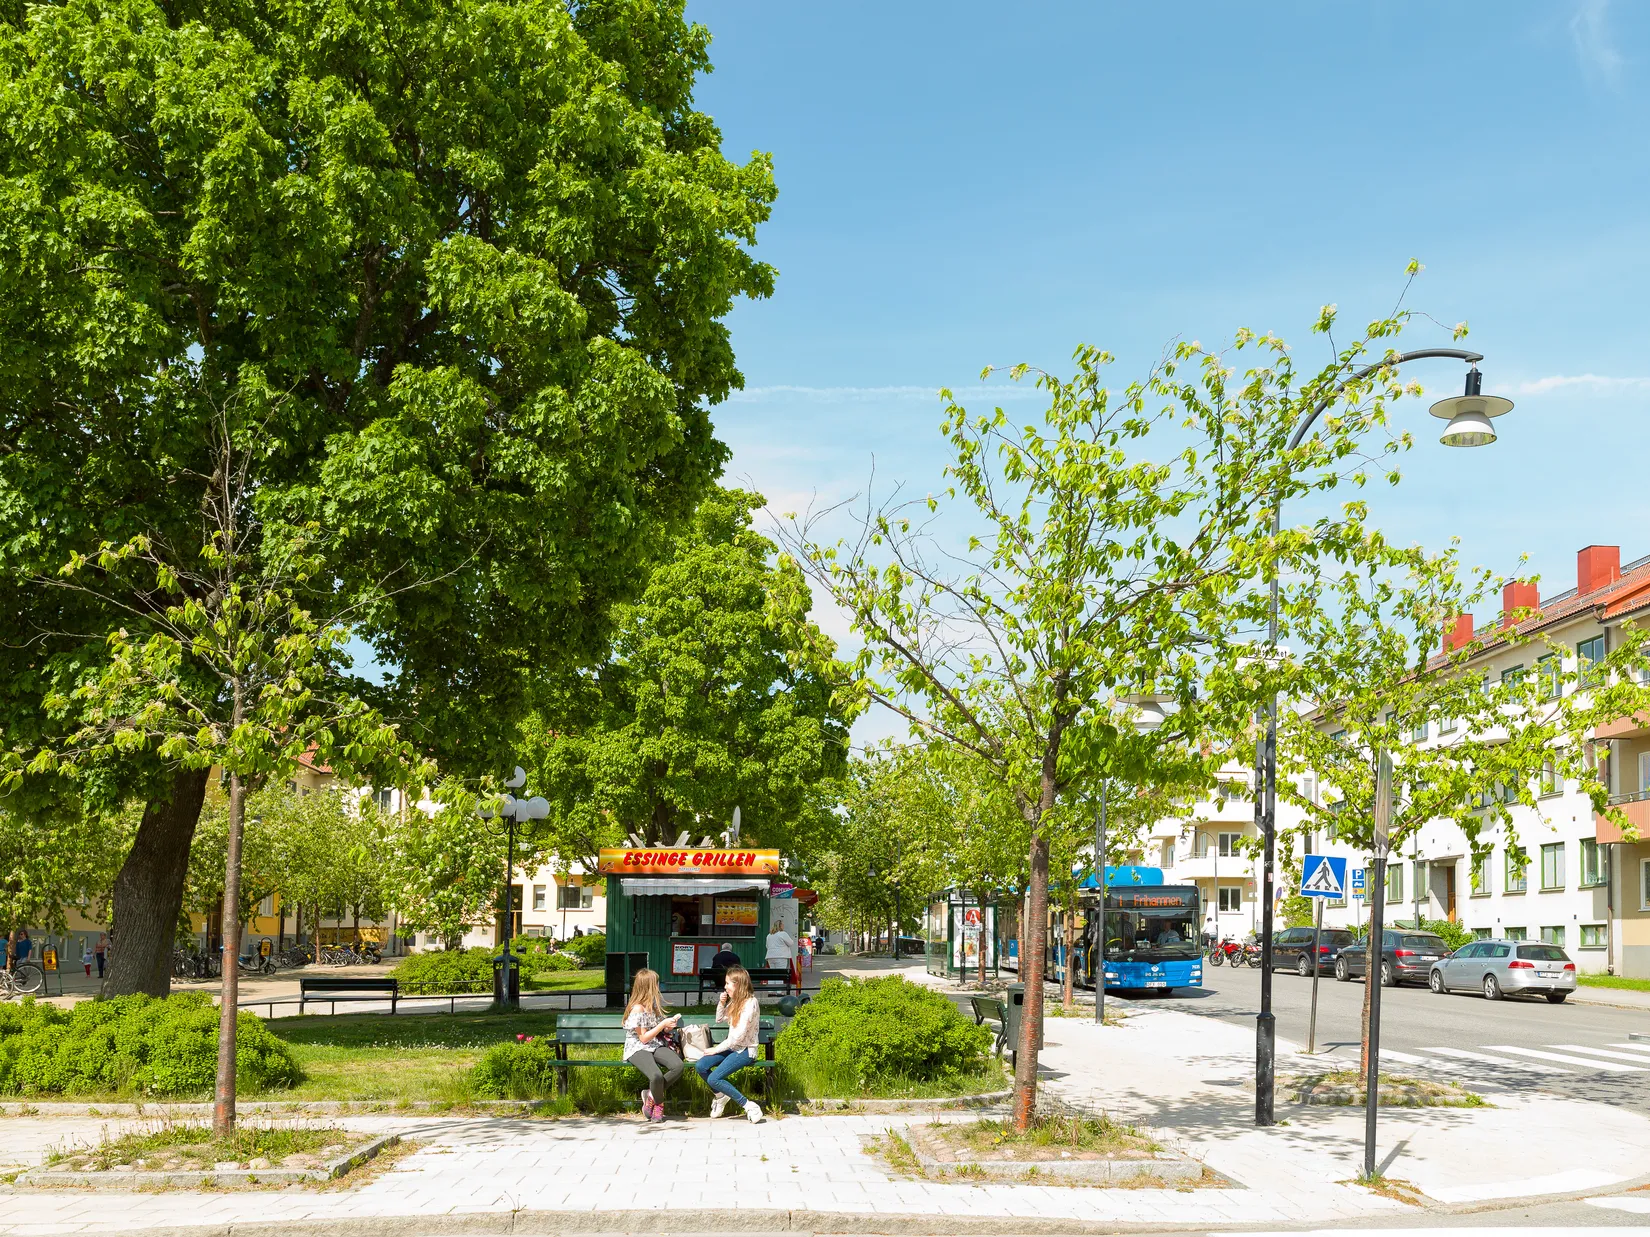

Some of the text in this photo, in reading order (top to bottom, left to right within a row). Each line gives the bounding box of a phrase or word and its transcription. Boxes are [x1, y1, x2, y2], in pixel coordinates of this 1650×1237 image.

[623, 852, 756, 866] ESSINGE GRILLEN
[1355, 870, 1362, 879] P
[1119, 894, 1182, 907] 1 Frihamnen
